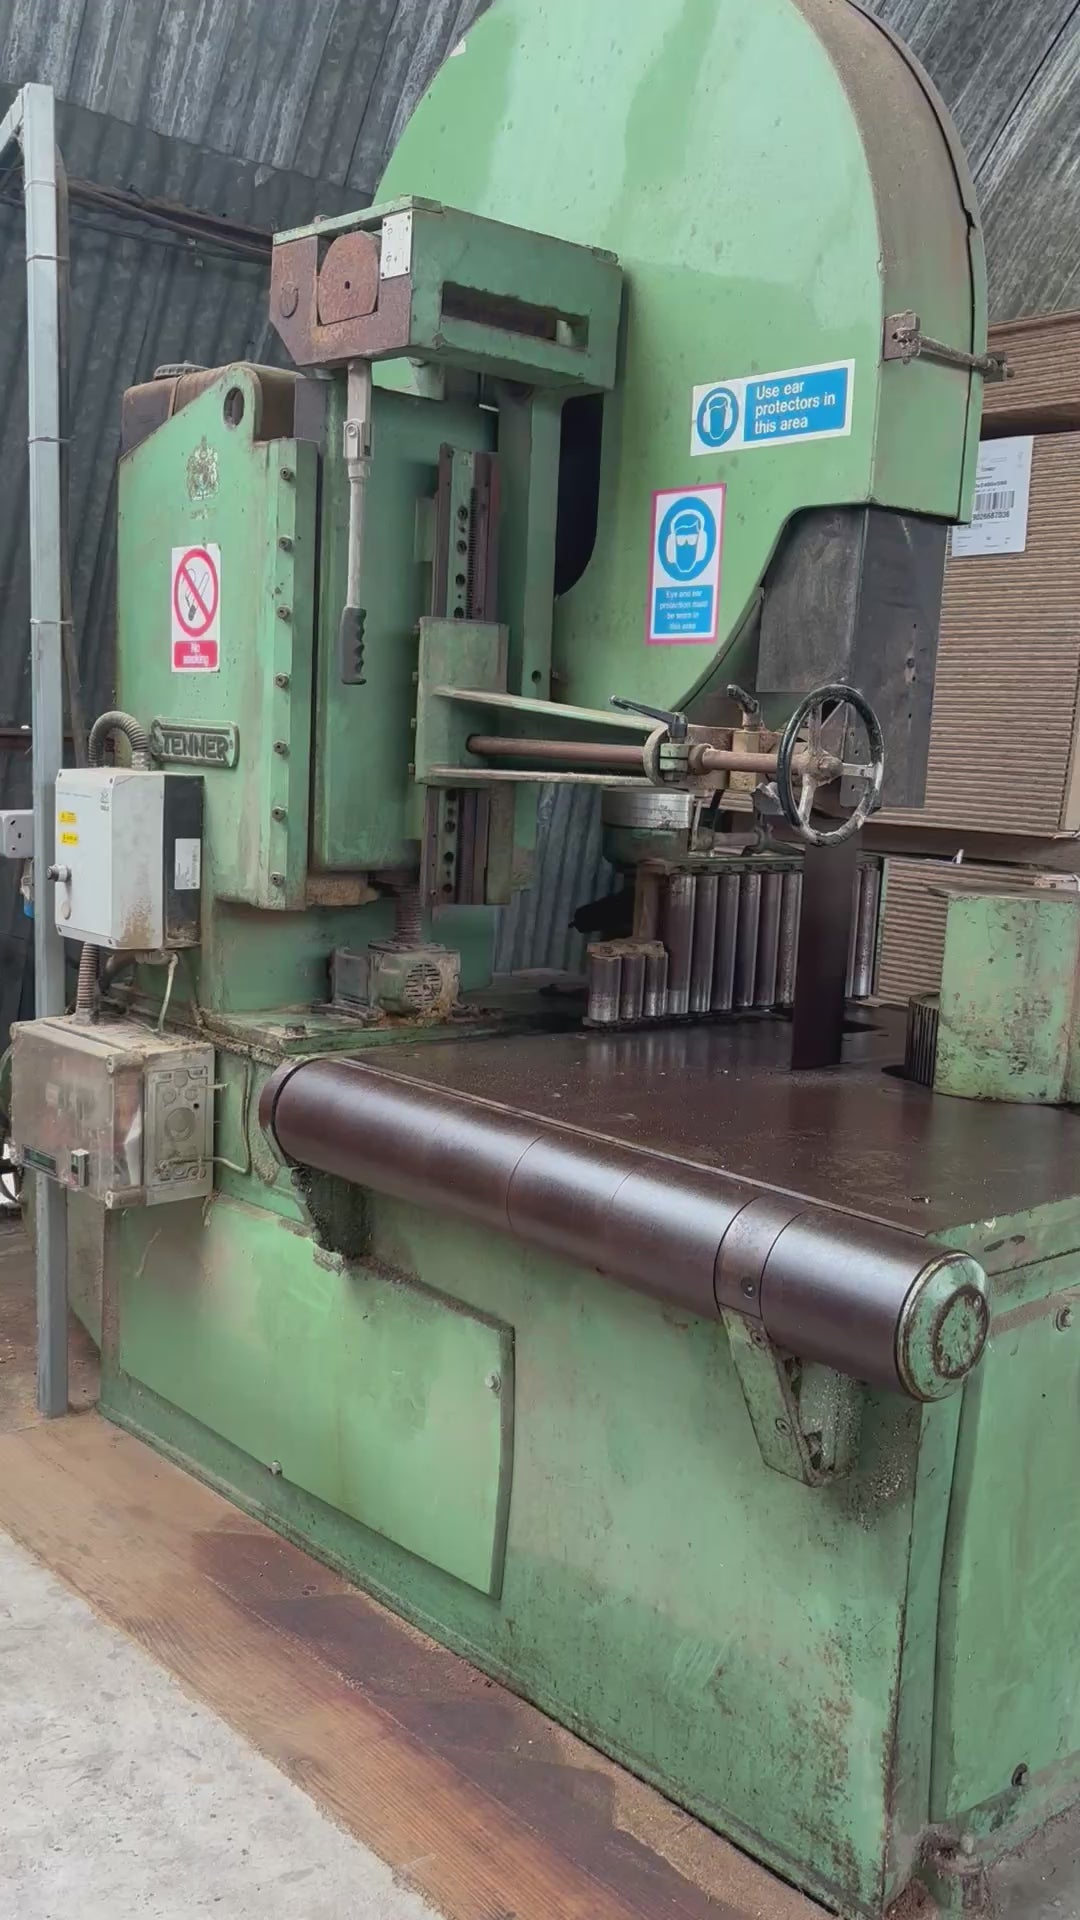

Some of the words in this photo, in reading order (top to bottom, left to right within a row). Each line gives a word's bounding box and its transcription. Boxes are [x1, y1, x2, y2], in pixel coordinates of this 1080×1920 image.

[756, 385, 780, 400] Use
[784, 381, 805, 395] ear
[755, 395, 820, 419] protectors
[823, 391, 836, 406] in
[754, 419, 777, 434] this
[780, 416, 808, 431] area
[151, 719, 231, 768] STENNER
